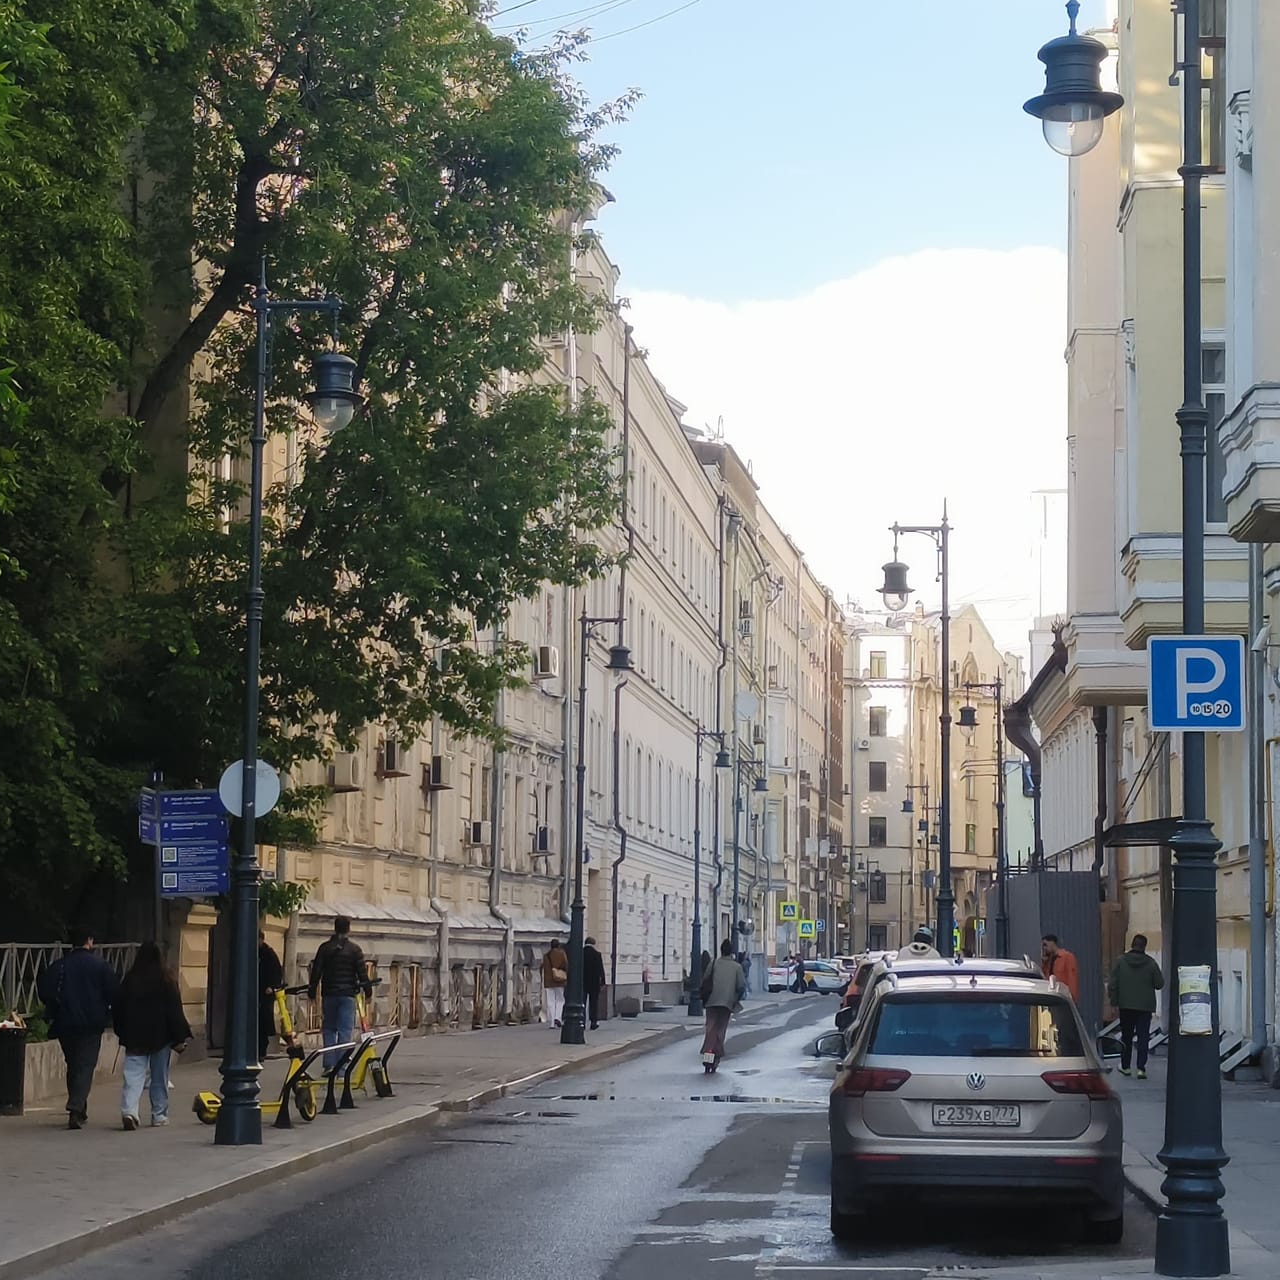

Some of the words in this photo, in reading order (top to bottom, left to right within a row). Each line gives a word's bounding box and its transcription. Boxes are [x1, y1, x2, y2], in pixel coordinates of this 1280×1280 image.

[1176, 647, 1226, 719] P
[1192, 705, 1200, 713] 10
[1204, 704, 1212, 714] 15
[1216, 703, 1230, 714] 20
